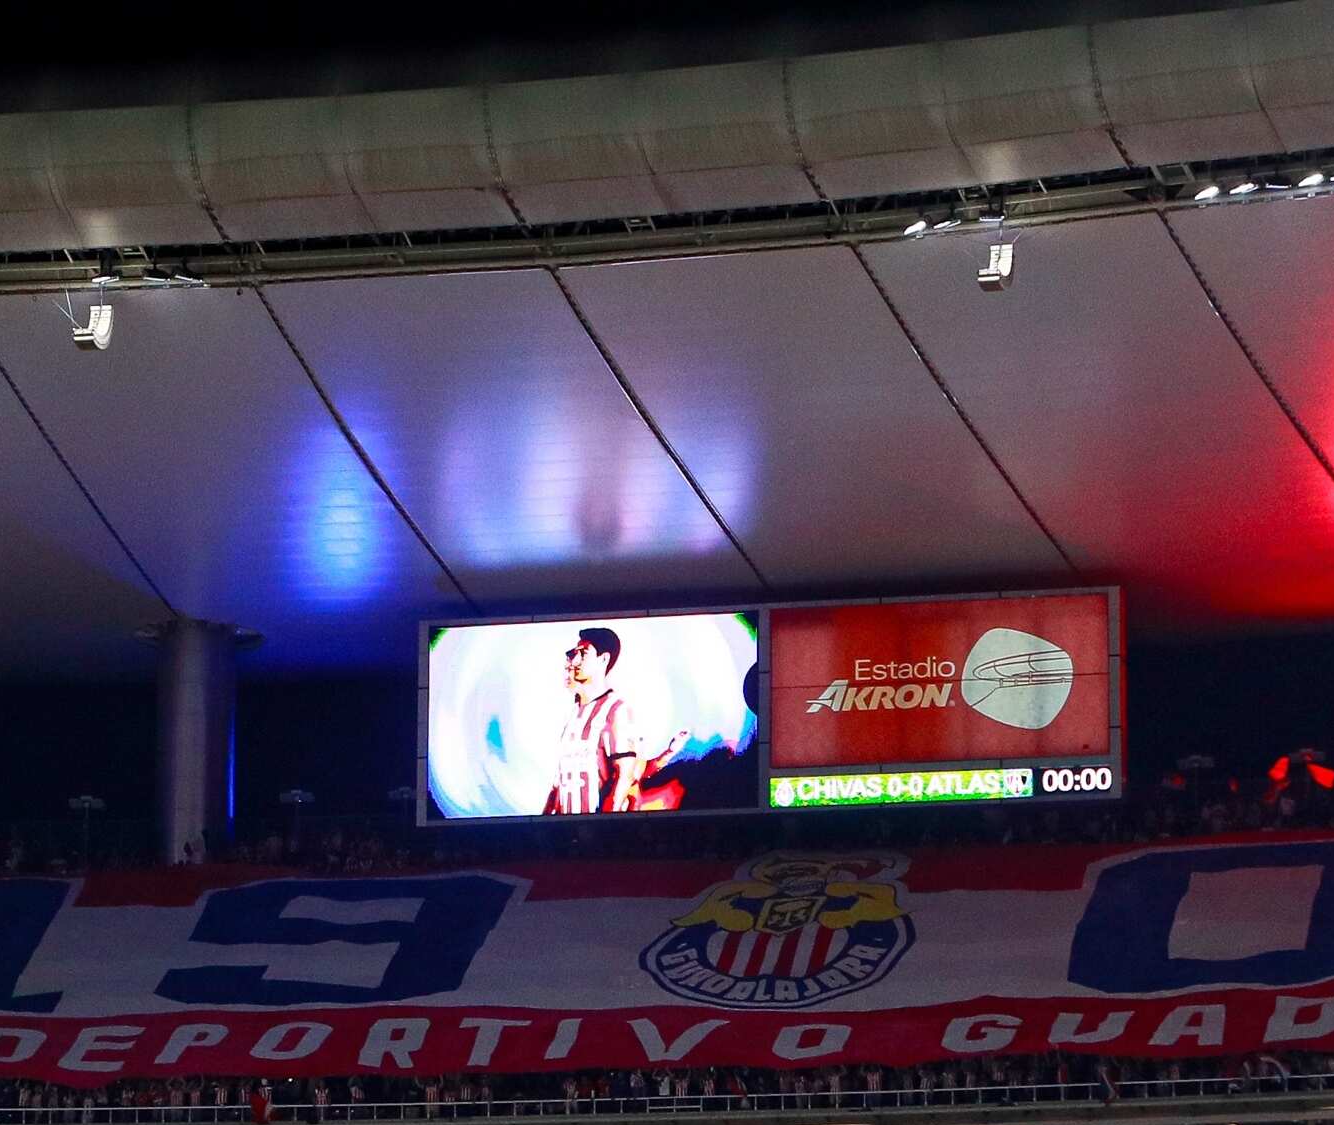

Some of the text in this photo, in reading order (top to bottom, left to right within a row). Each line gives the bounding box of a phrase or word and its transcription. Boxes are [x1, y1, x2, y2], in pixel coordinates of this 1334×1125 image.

[855, 656, 955, 681] Estadio
[806, 680, 953, 713] AKRON
[797, 772, 1001, 801] CHIVAS 0-0 ATLAS
[1042, 767, 1113, 793] 00:00
